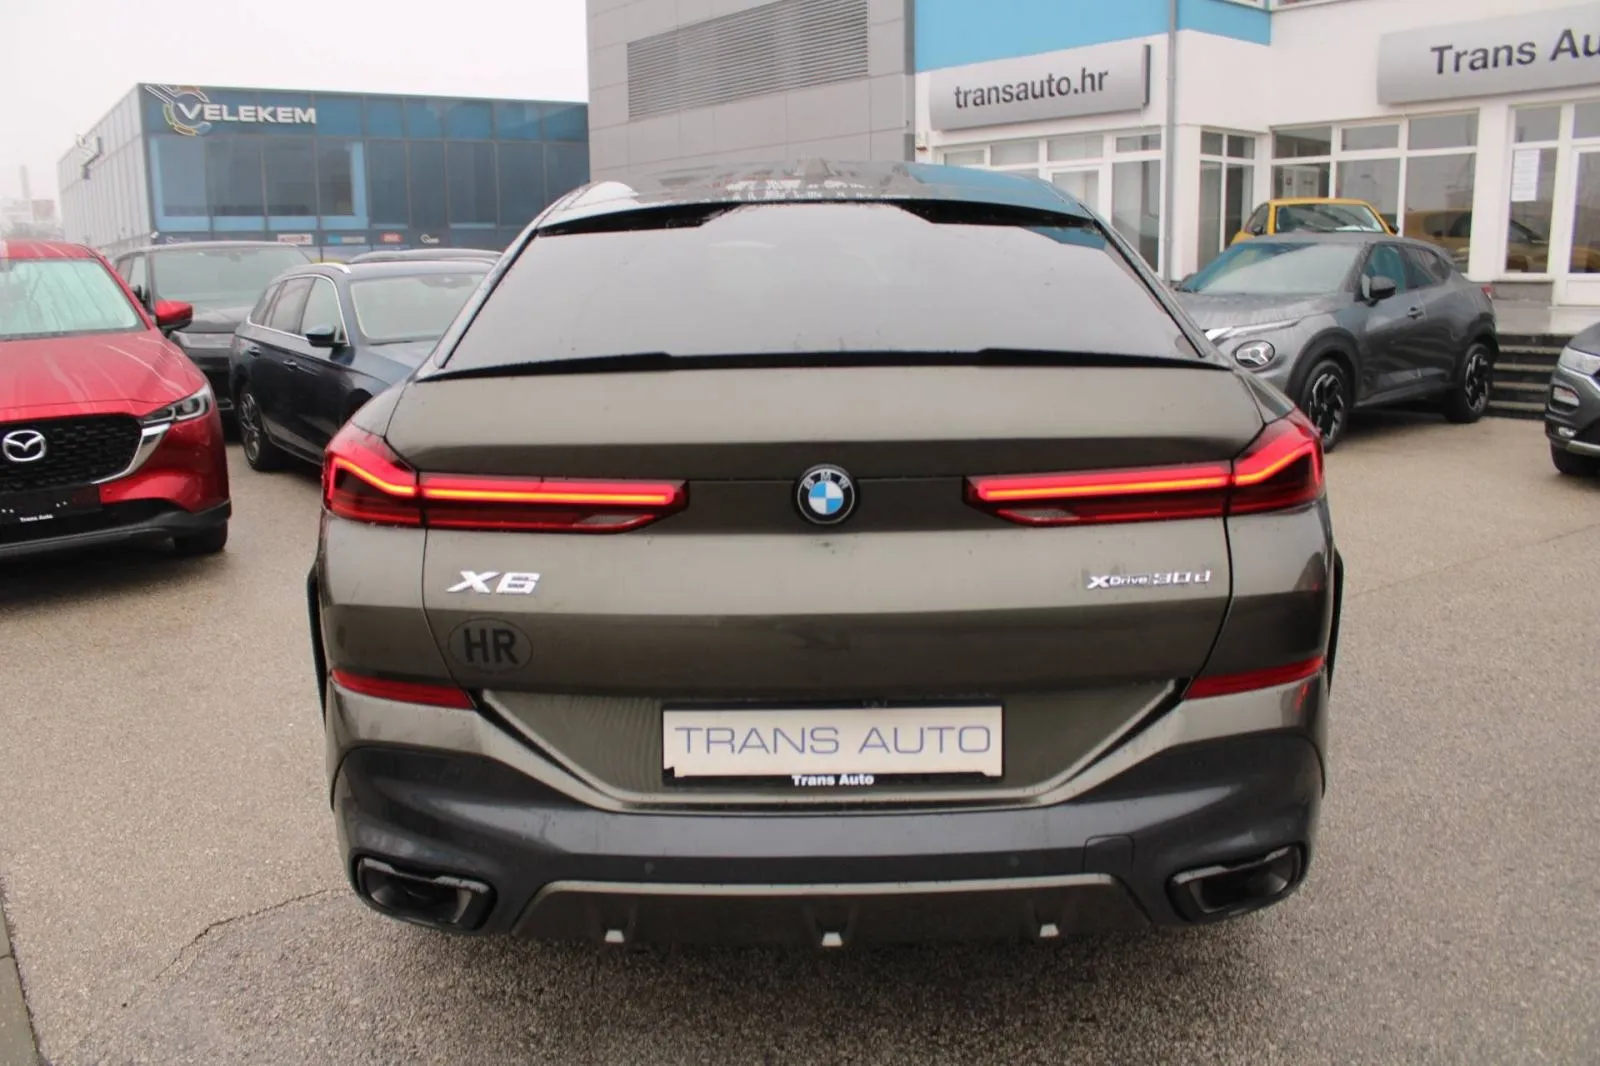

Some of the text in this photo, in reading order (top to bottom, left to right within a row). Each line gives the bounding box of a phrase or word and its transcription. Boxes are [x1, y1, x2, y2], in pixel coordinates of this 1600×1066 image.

[1430, 41, 1537, 75] Trans
[954, 66, 1109, 109] transauto.hr
[177, 103, 318, 124] VELEKEM
[446, 571, 540, 594] X6
[463, 628, 519, 664] HR
[674, 726, 991, 754] TRANS AUTO
[791, 773, 875, 786] Trans Auto
